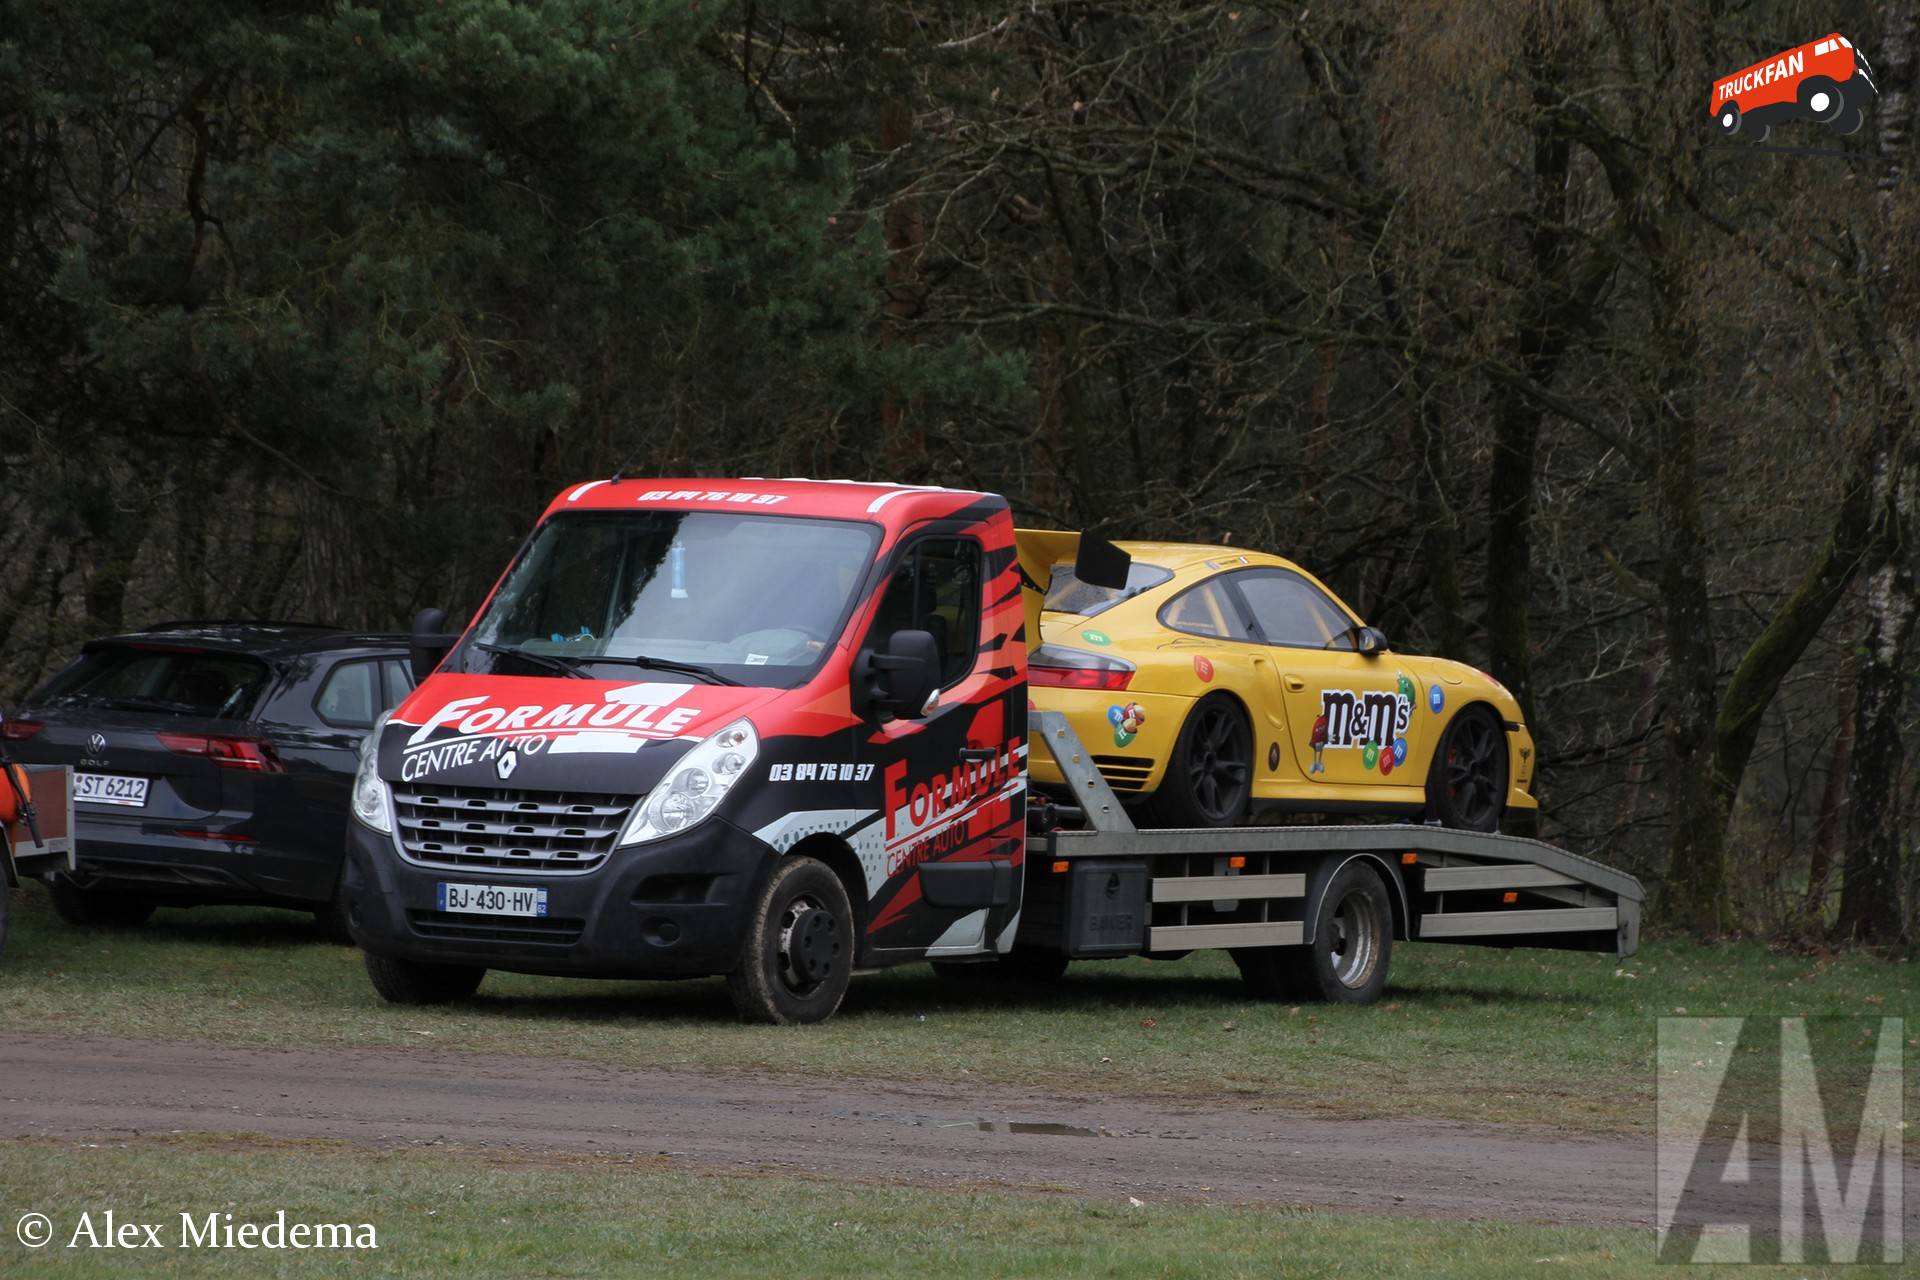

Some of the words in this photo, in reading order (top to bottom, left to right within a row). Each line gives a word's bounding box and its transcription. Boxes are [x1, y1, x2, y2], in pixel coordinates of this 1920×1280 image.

[637, 490, 672, 501] 03
[407, 695, 701, 747] FORMULE
[80, 758, 110, 768] GOLF
[402, 739, 481, 783] CENTRE
[478, 734, 547, 761] AUTO
[769, 763, 794, 782] 03
[795, 763, 818, 781] 84
[819, 763, 838, 781] 76
[839, 763, 855, 781] 10
[854, 763, 876, 781] 37
[105, 778, 145, 799] 6212
[884, 736, 1021, 842] FORMULE
[887, 836, 930, 878] CENTRE
[449, 887, 534, 912] BJ-430-HV
